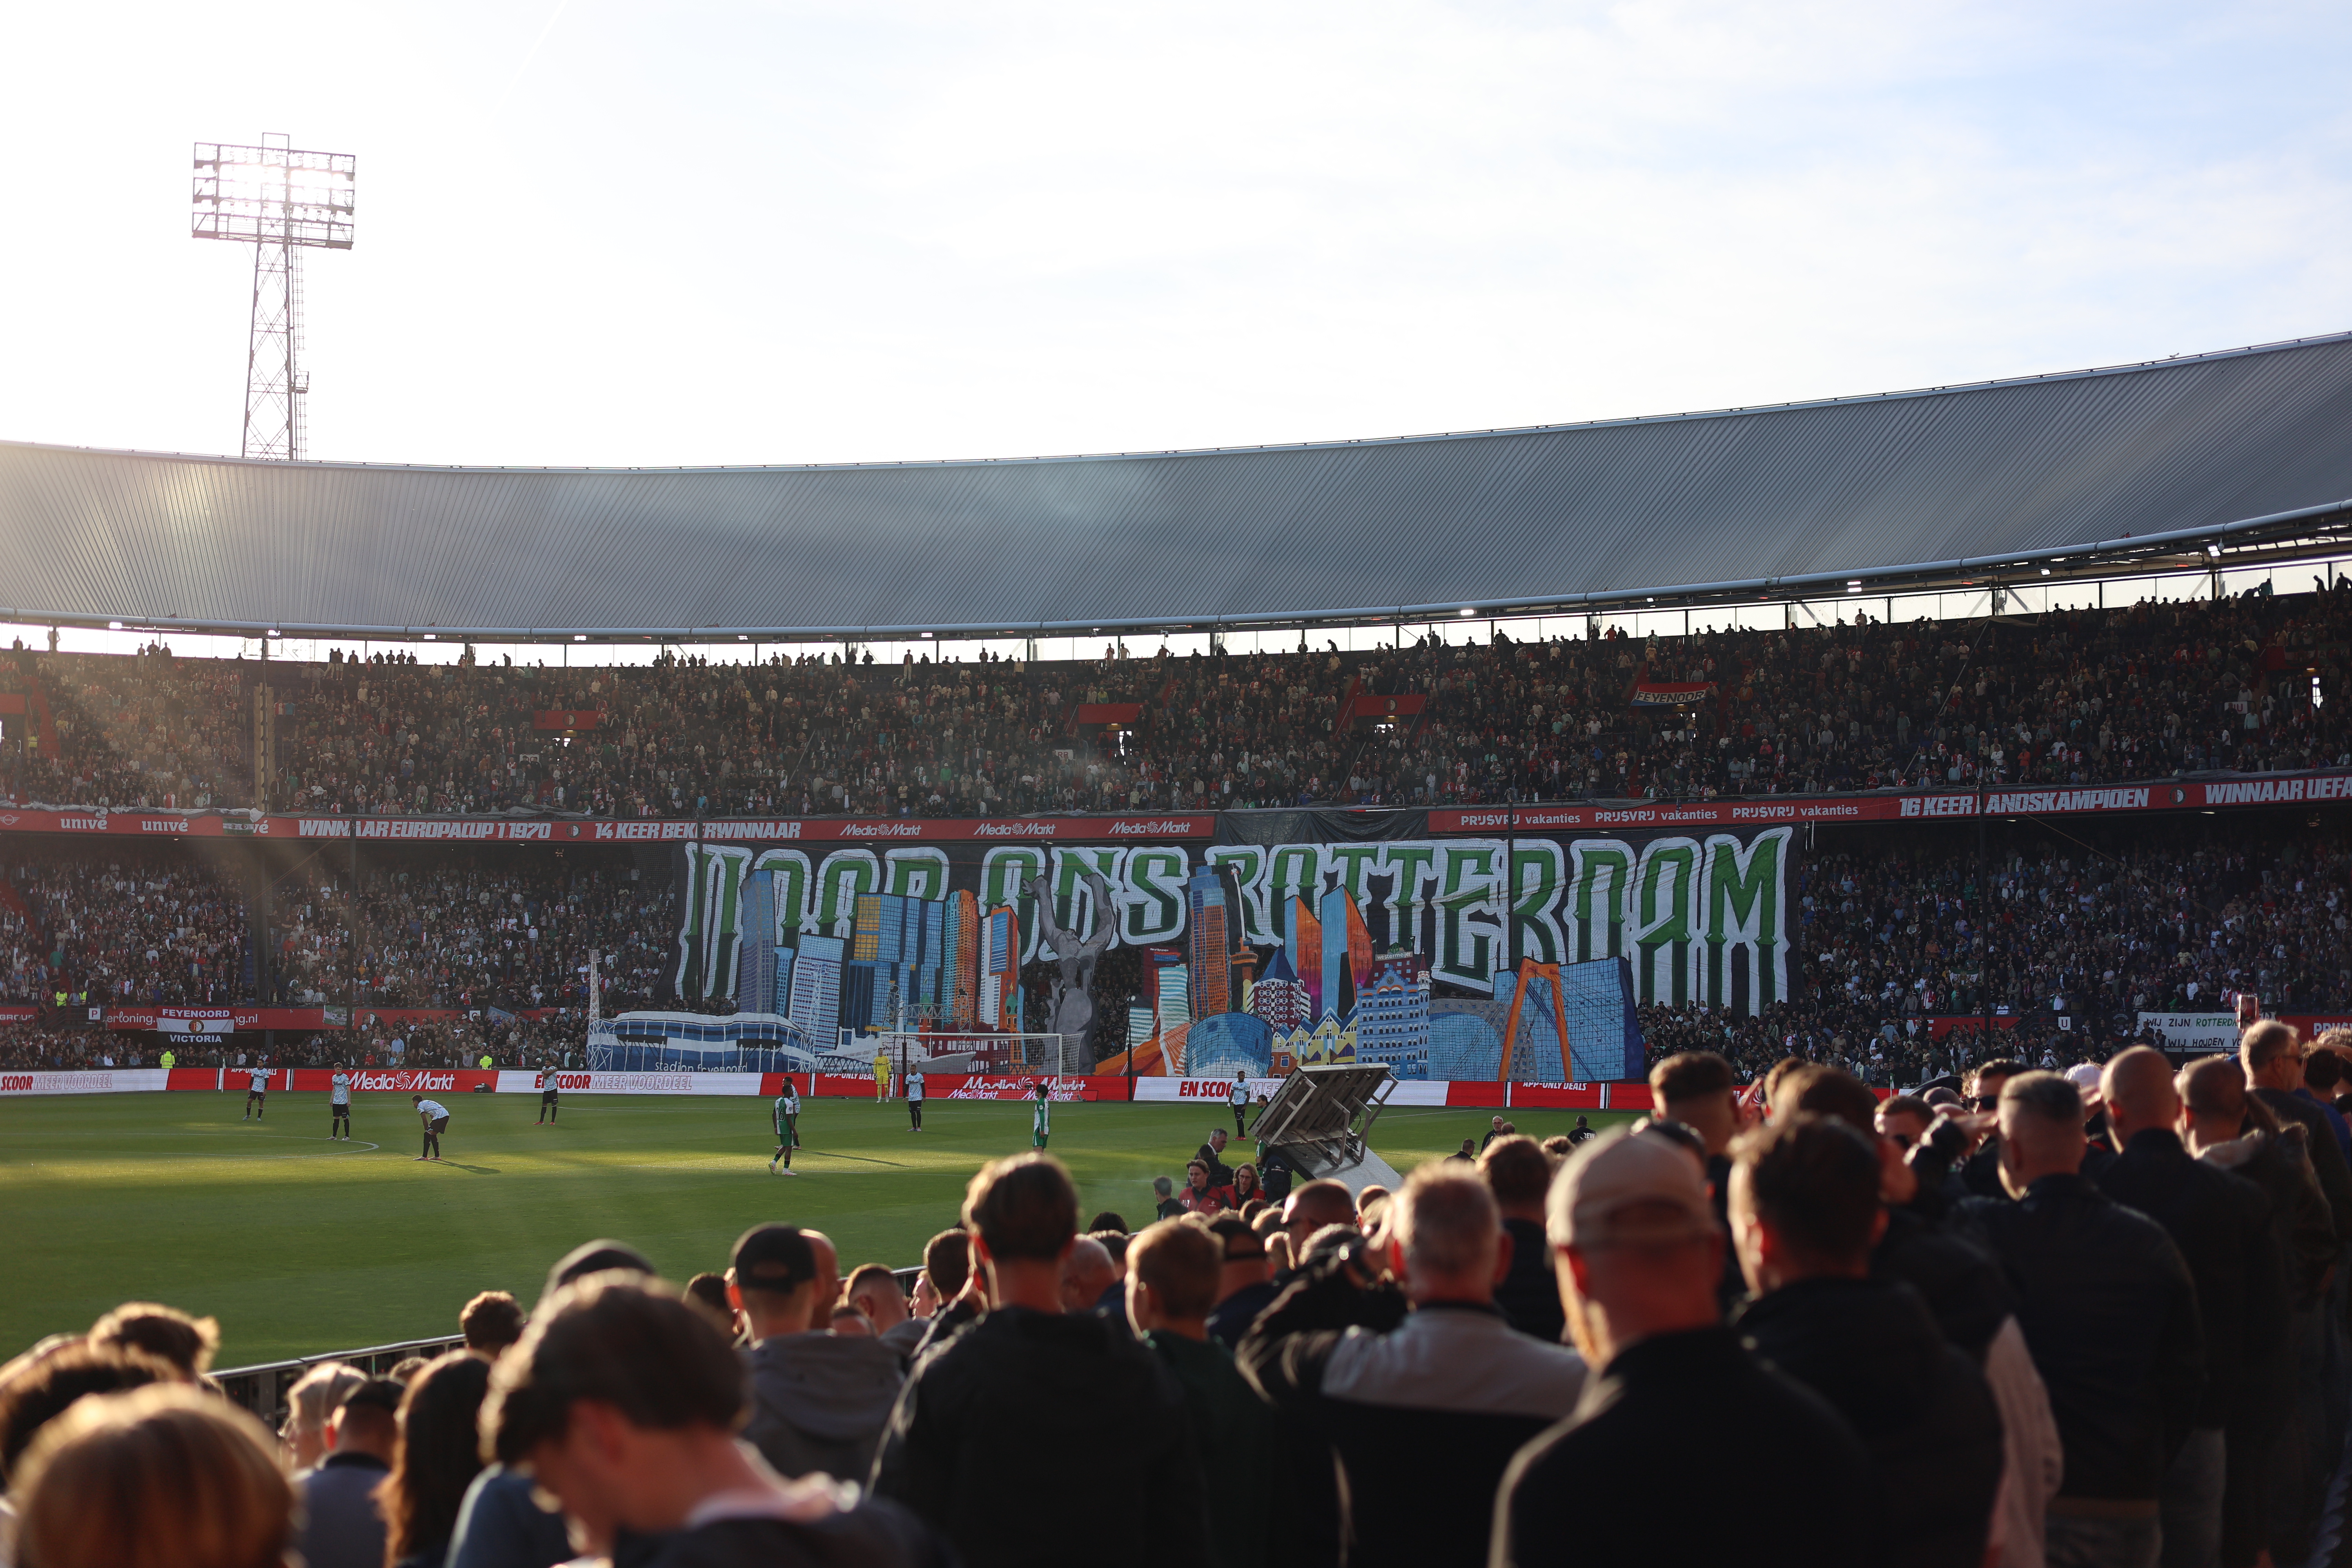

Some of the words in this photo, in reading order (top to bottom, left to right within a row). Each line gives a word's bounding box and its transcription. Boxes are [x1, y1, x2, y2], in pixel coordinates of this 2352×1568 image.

[1636, 691, 1705, 703] FEYENOOR
[2205, 779, 2304, 804] WINNAAR
[2307, 777, 2352, 799] UEFA
[1800, 805, 1858, 817] vakanties
[1899, 797, 1922, 817] 16
[1922, 796, 1974, 817] KEER
[1525, 814, 1581, 825] vakanties
[1661, 809, 1717, 820] vakanties
[142, 818, 188, 831] univé
[389, 821, 494, 838] EUROPACUP
[508, 823, 552, 838] 1970
[839, 824, 877, 836] Media
[887, 824, 921, 836] Markt
[973, 823, 1011, 835] Media
[1022, 823, 1056, 835] Markt
[1108, 822, 1146, 834] Media
[1156, 821, 1191, 833] Markt
[595, 823, 613, 839] 14
[615, 823, 660, 839] KEER
[977, 846, 1189, 967] ONS
[1204, 825, 1794, 1017] ROTTERDAM
[162, 1008, 230, 1018] FEYENOORD
[2061, 1019, 2067, 1027] U
[2169, 1018, 2190, 1027] ZIJN
[2196, 1018, 2238, 1027] ROTTERDA
[169, 1034, 222, 1043] VICTORIA
[2168, 1038, 2187, 1047] WIJ
[2192, 1038, 2225, 1047] HOUDEN
[655, 1061, 694, 1072] stadion
[1, 1076, 33, 1091] SCOOR
[34, 1075, 63, 1090] MEER
[64, 1074, 112, 1089] VOORDEEL
[349, 1071, 395, 1090] Media
[408, 1071, 455, 1090] Markt
[556, 1074, 591, 1089] SCOOR
[592, 1075, 628, 1090] MEER
[630, 1075, 692, 1091] VOORDEEL
[1179, 1081, 1199, 1097] EN
[1200, 1081, 1233, 1097] SCOO
[1563, 1083, 1587, 1091] DEALS
